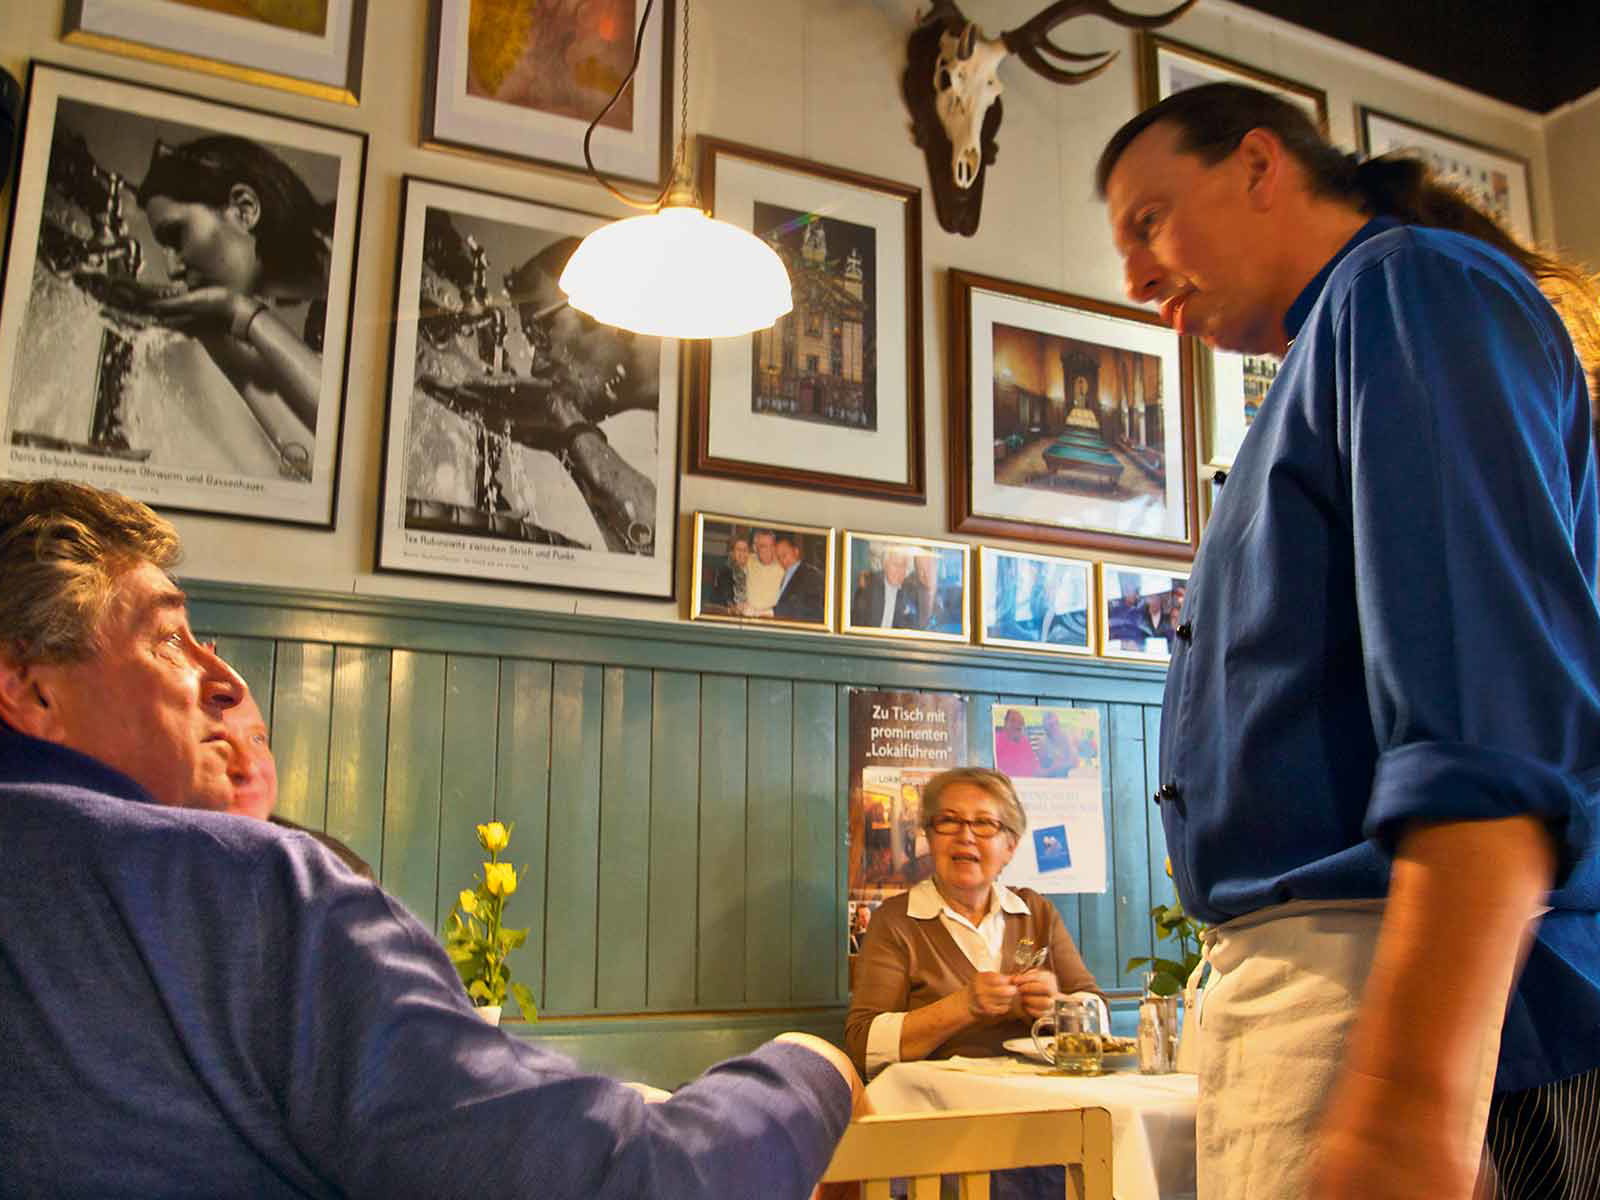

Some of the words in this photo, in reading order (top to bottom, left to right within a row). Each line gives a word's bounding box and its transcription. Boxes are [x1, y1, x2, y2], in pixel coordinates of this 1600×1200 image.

[186, 473, 203, 483] und
[536, 550, 550, 559] und
[872, 705, 889, 719] Zu
[893, 706, 923, 721] Tisch
[927, 709, 945, 723] mit
[871, 726, 948, 742] prominenten
